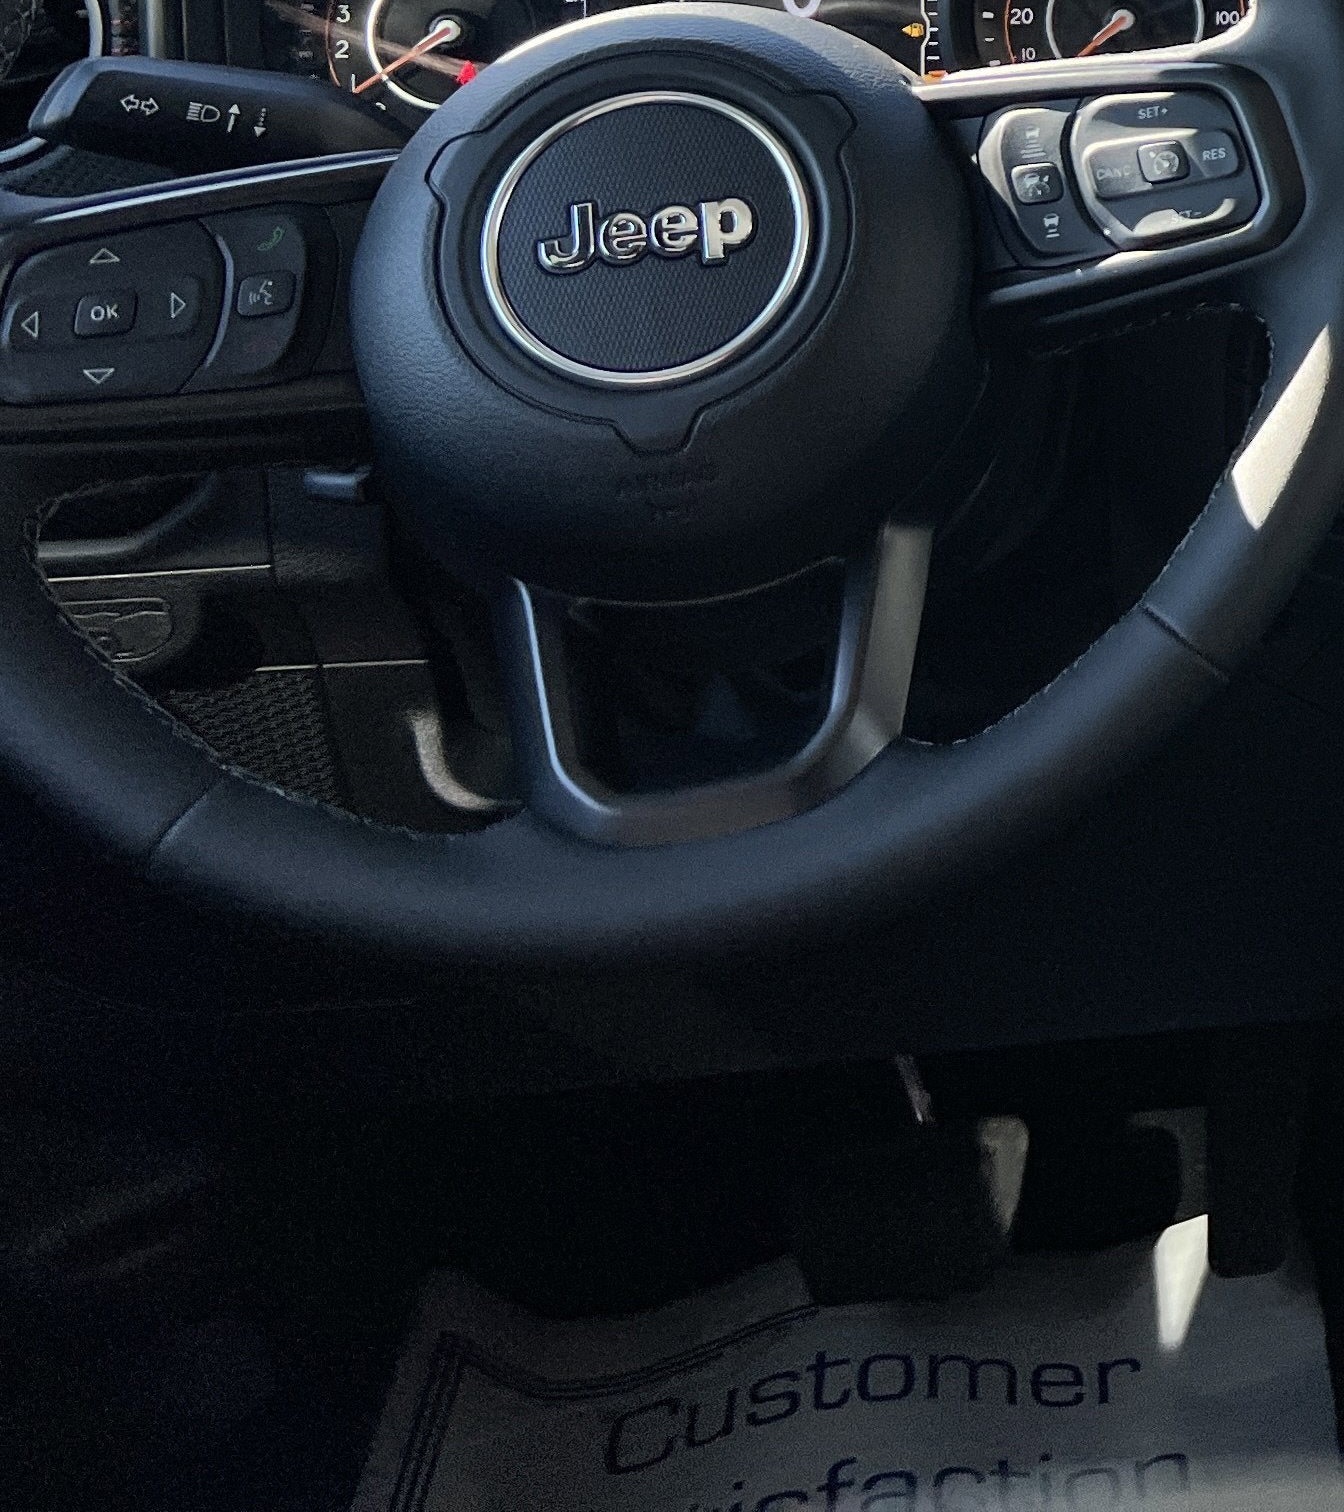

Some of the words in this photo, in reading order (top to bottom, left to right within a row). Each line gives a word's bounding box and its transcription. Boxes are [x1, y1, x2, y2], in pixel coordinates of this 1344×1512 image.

[336, 4, 351, 23] 3
[1010, 7, 1034, 25] 20
[1215, 10, 1240, 26] 100
[335, 40, 349, 59] 2
[1021, 46, 1036, 62] 10
[1138, 105, 1169, 120] SET+
[1202, 147, 1227, 161] RES
[1096, 164, 1131, 181] CANC
[537, 197, 753, 274] Jeep
[90, 303, 120, 323] OK
[604, 1350, 1141, 1474] Customer
